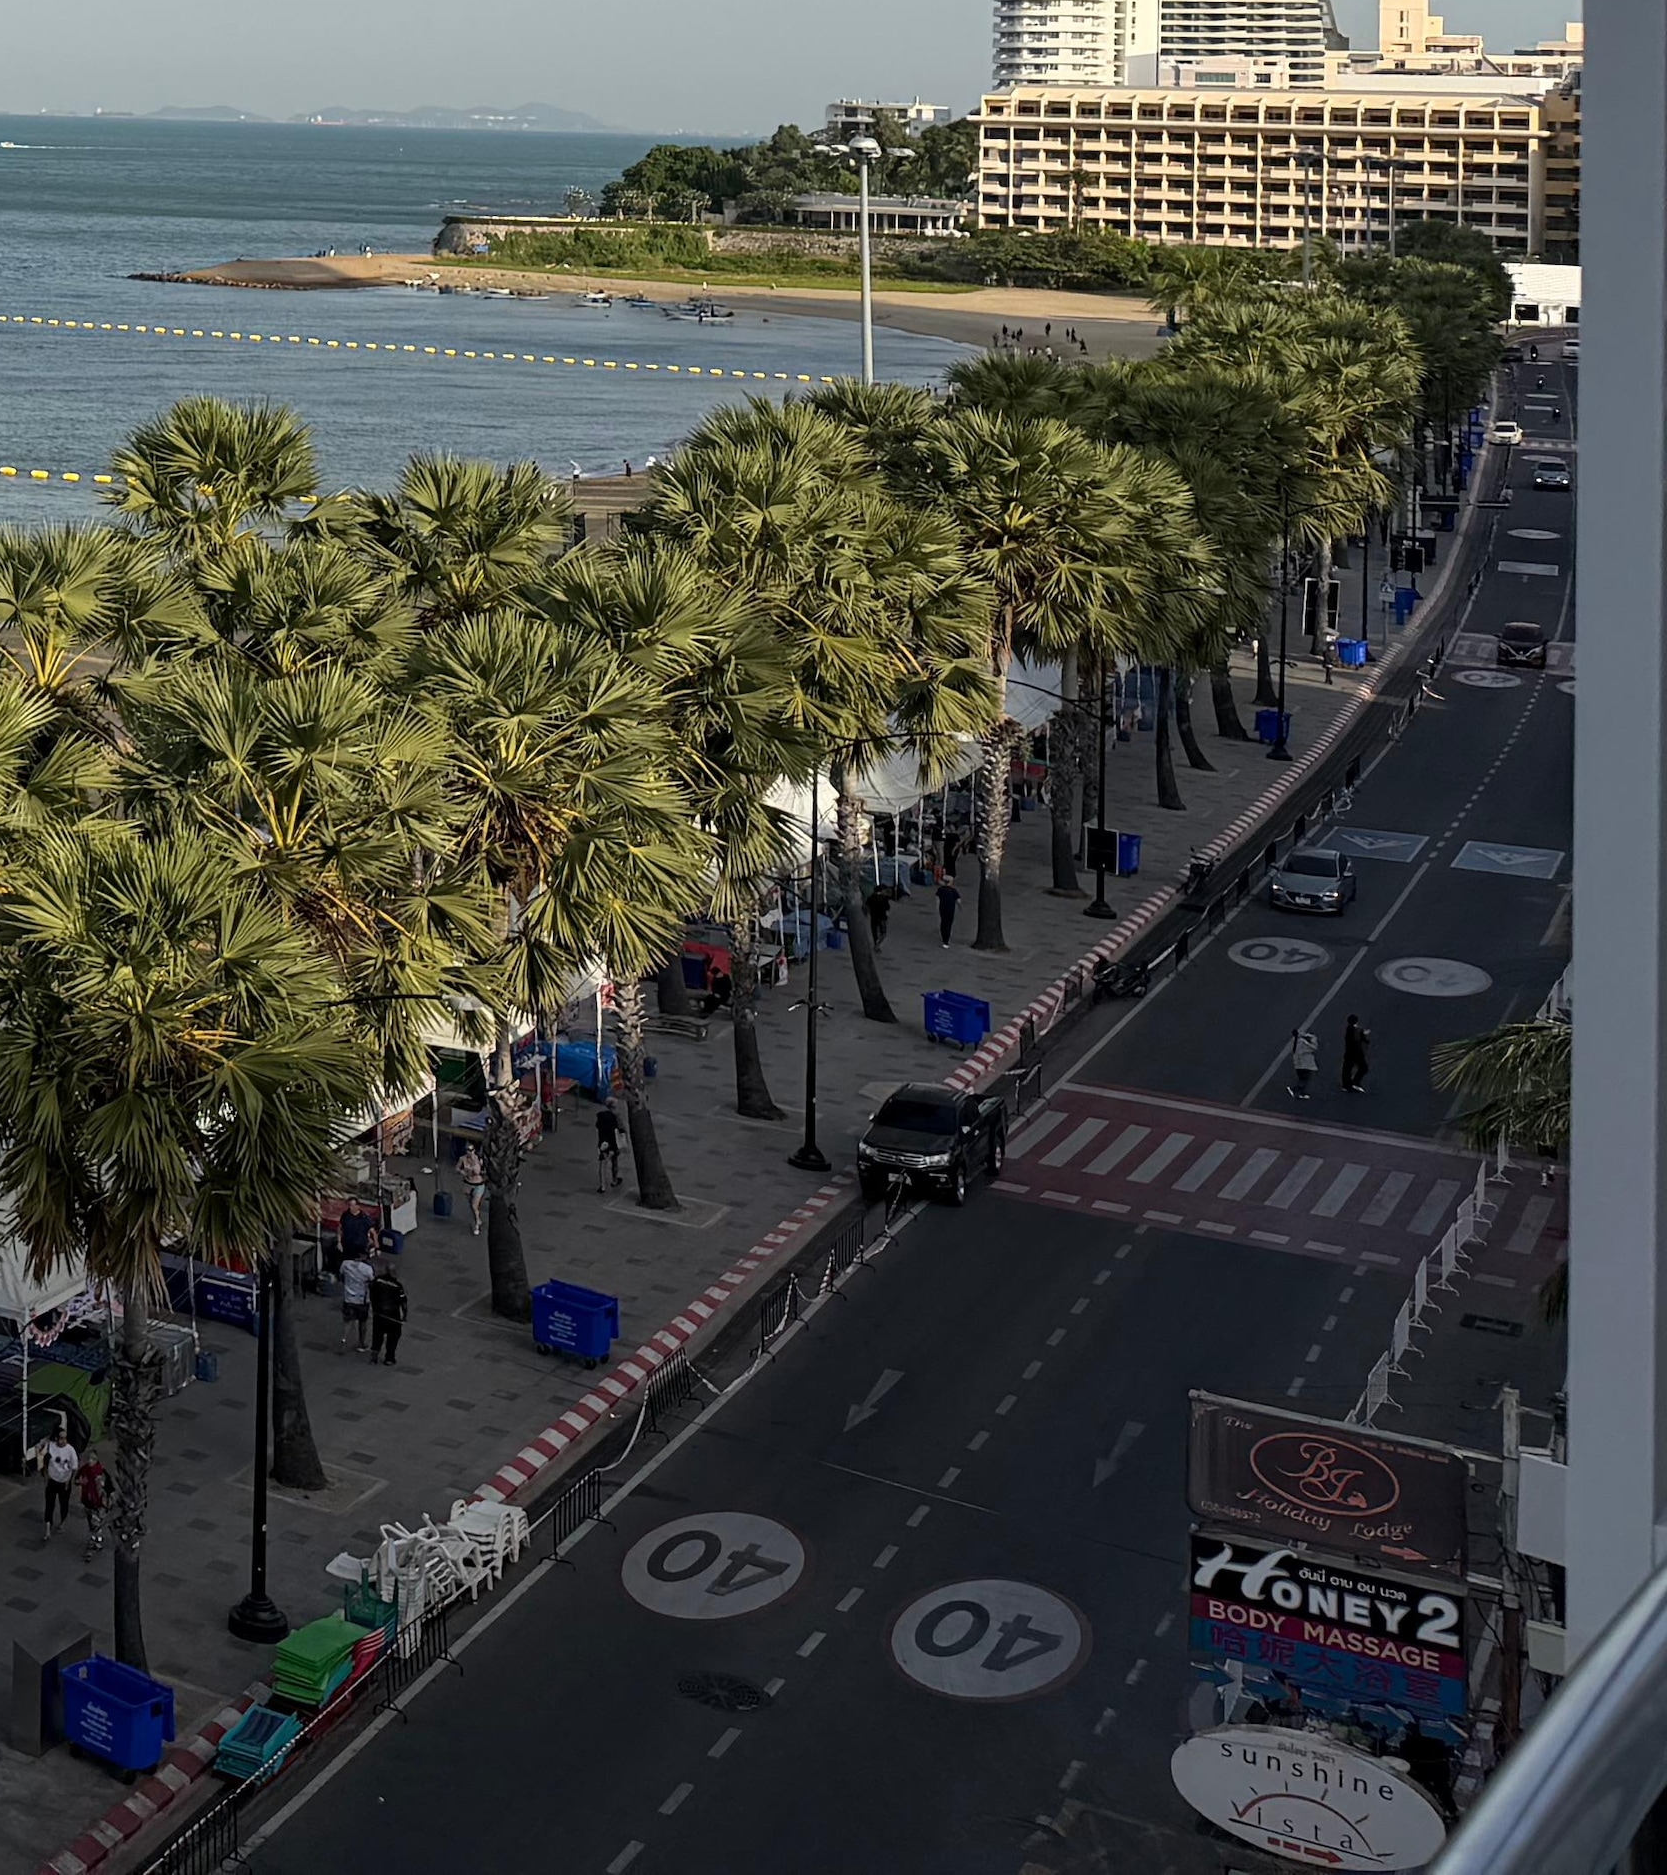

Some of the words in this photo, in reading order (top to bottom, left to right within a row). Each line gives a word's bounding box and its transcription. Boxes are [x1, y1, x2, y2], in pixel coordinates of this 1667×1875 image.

[1240, 943, 1320, 965] 40
[1236, 1488, 1332, 1532] Holiday
[1349, 1522, 1413, 1541] Lodge
[647, 1529, 791, 1596] 40
[915, 1600, 1063, 1673] 40
[1208, 1599, 1285, 1634] BODY
[1303, 1620, 1440, 1672] MASSAGE
[1221, 1742, 1394, 1801] sunshine
